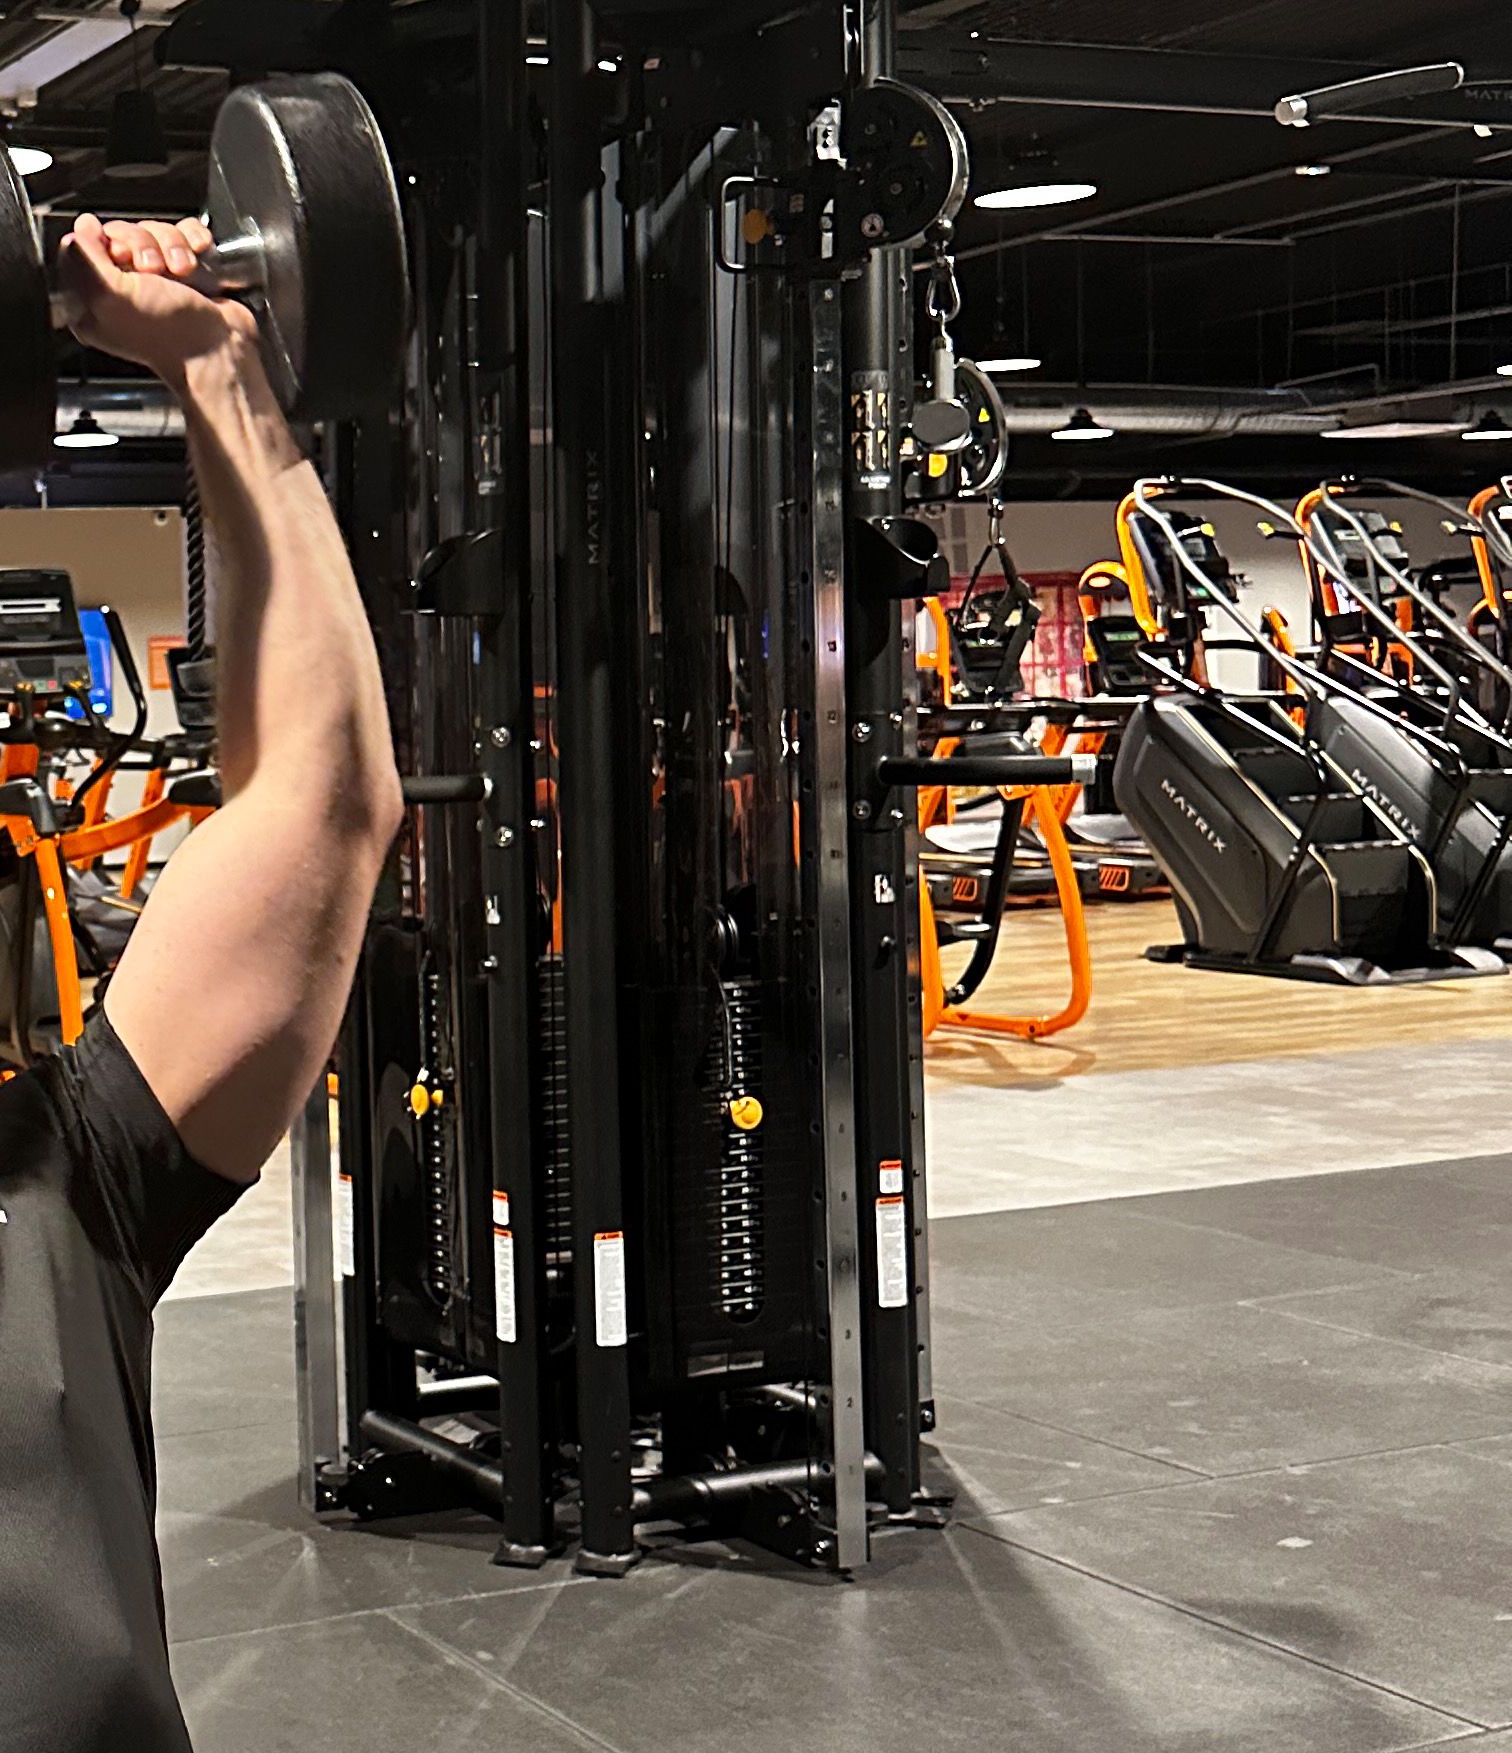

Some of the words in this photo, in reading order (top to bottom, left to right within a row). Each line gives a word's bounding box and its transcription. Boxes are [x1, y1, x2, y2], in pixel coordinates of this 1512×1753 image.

[586, 450, 600, 564] MATRIX
[1160, 779, 1227, 854] MATRIX
[1350, 768, 1422, 841] MATRIX
